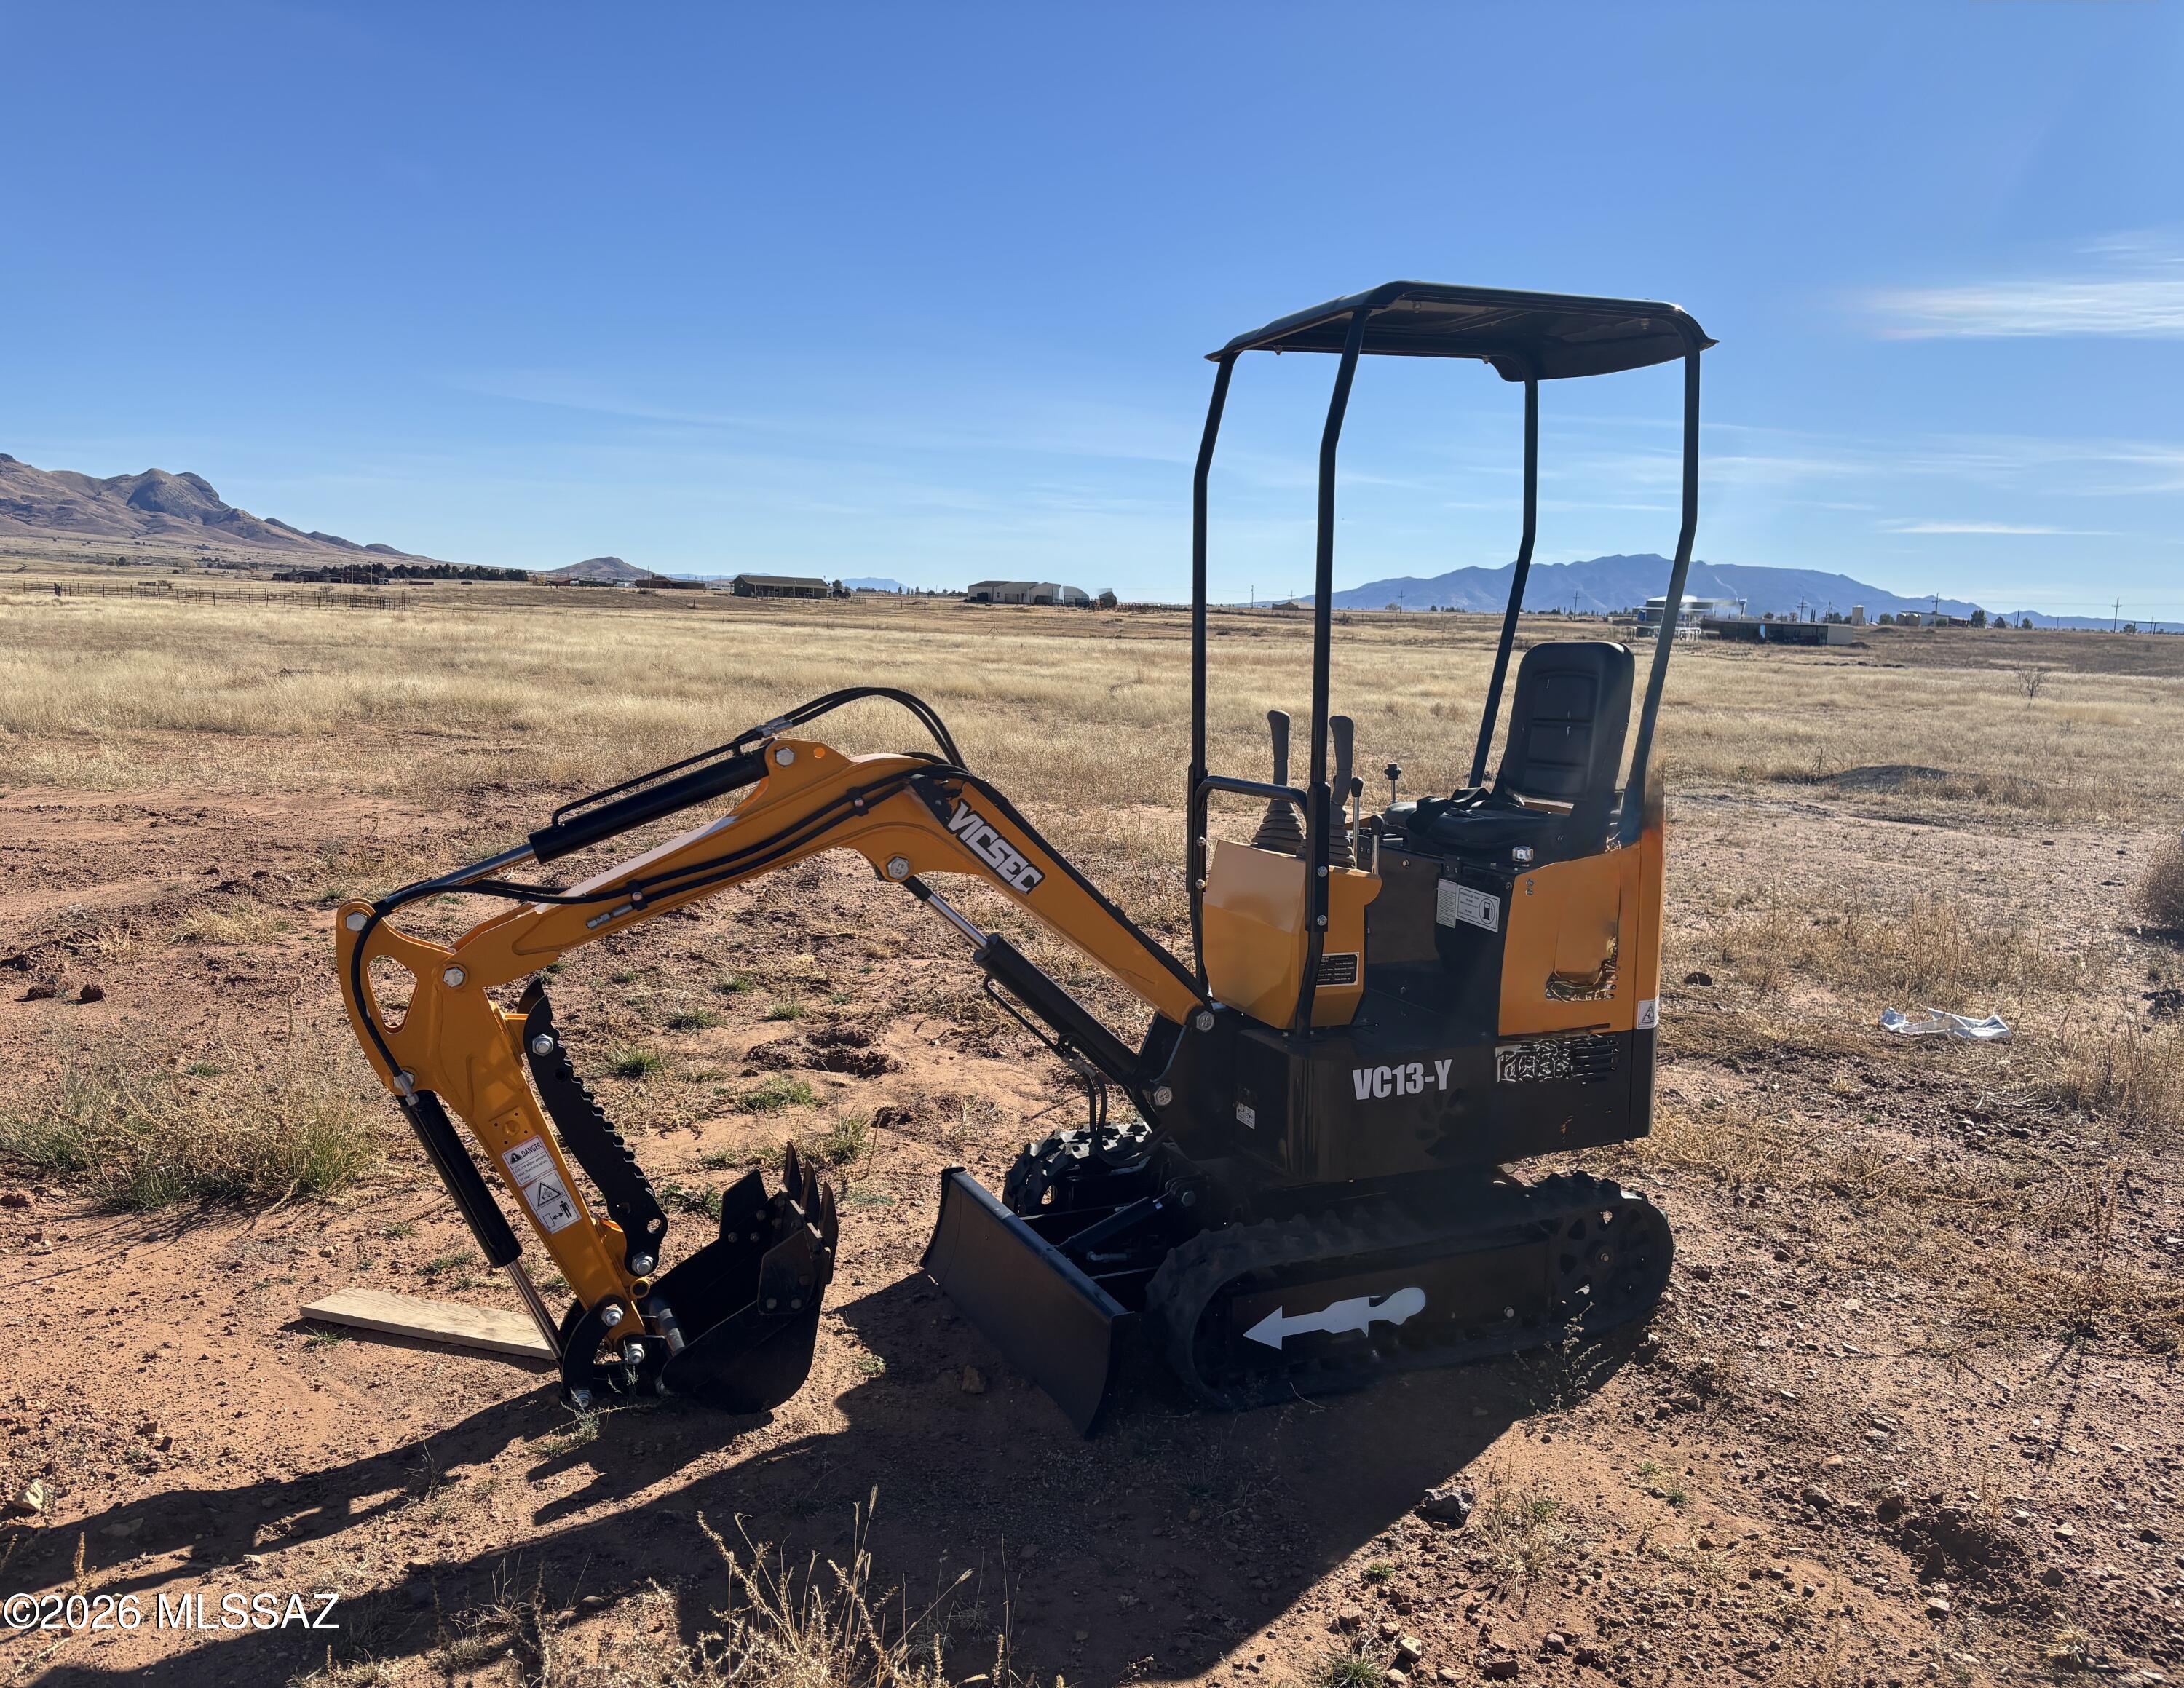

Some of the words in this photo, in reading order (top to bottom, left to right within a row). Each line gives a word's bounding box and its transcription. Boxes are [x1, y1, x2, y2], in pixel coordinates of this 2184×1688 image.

[947, 801, 1043, 892] VICSEC
[1352, 1058, 1453, 1101] VC13-Y
[521, 1142, 542, 1157] DANGER
